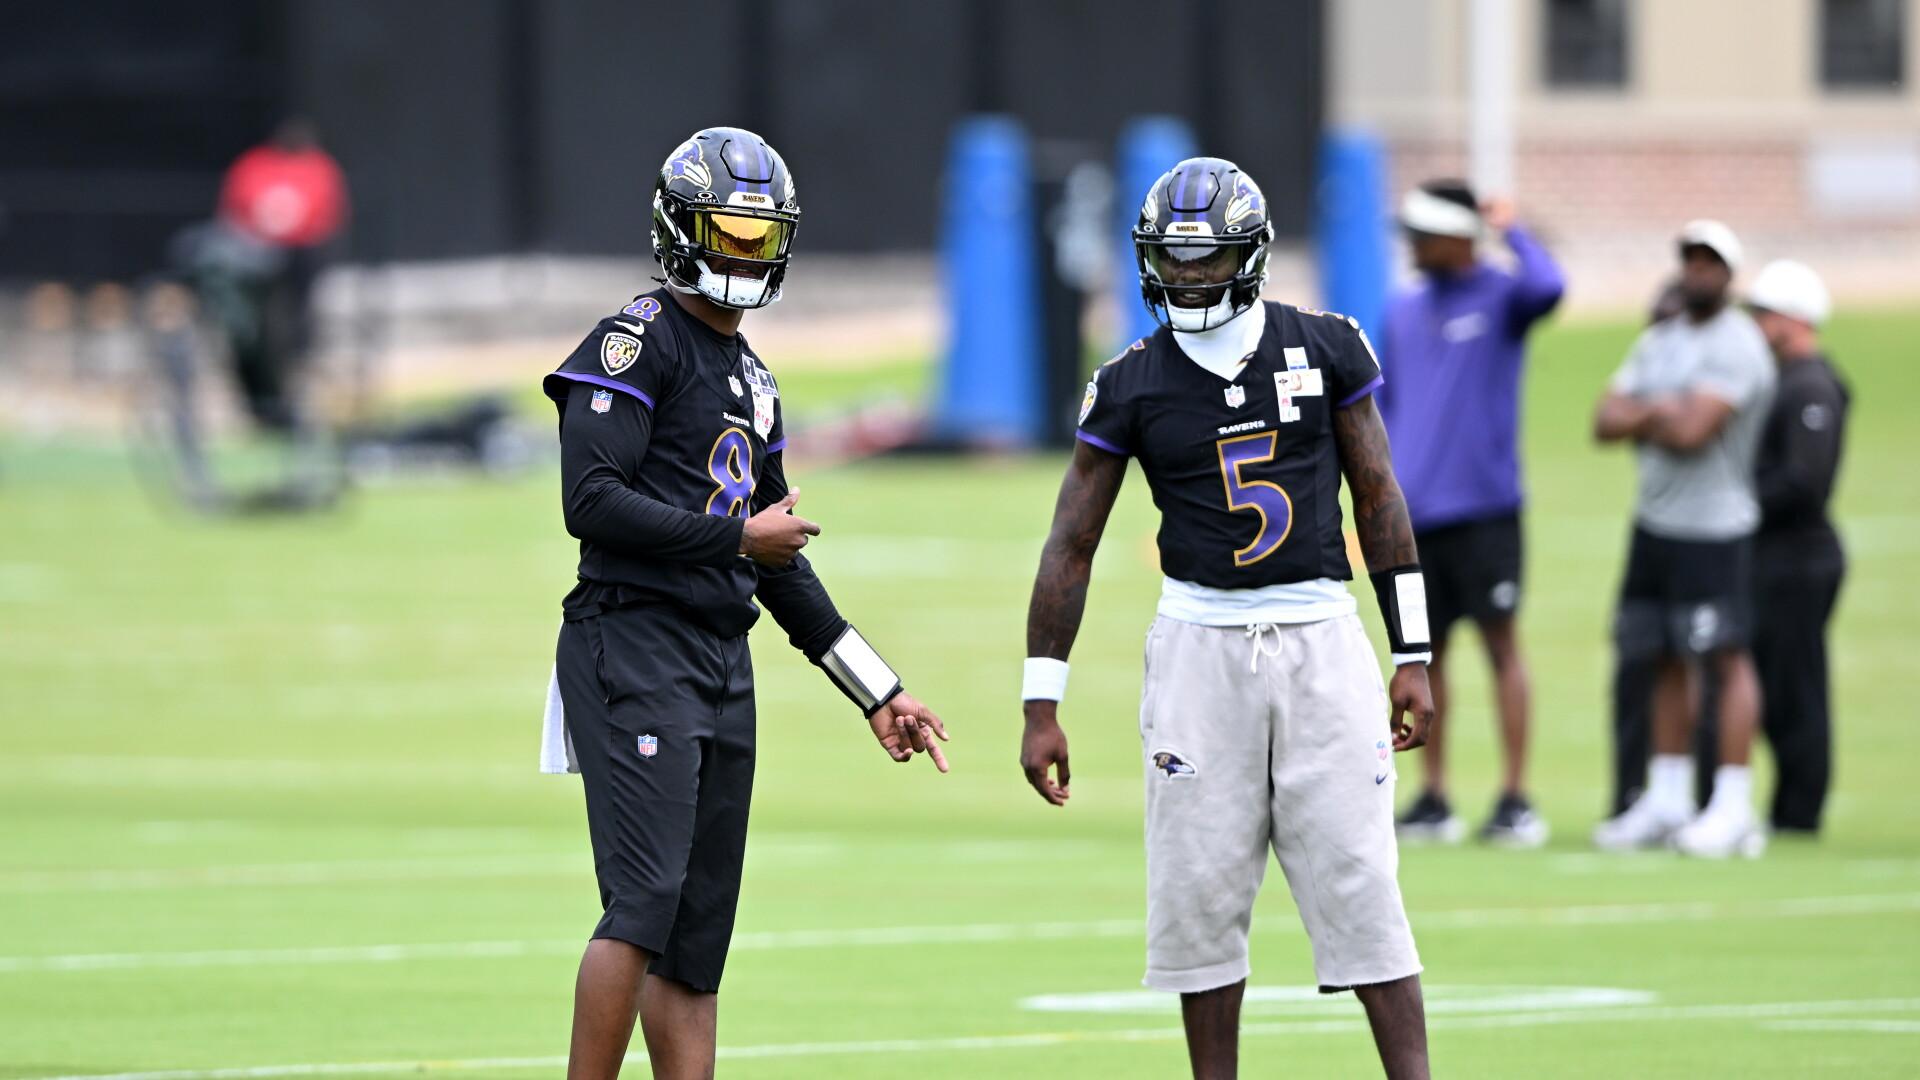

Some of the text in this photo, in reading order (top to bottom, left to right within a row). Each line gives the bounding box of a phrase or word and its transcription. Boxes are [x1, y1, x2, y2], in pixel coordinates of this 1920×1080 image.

[742, 194, 765, 203] RAVENS
[623, 296, 662, 322] 8
[594, 400, 608, 410] NFL
[1218, 420, 1266, 434] RAVENS
[705, 426, 757, 519] 8
[1216, 429, 1293, 567] 5
[641, 744, 655, 753] NFL
